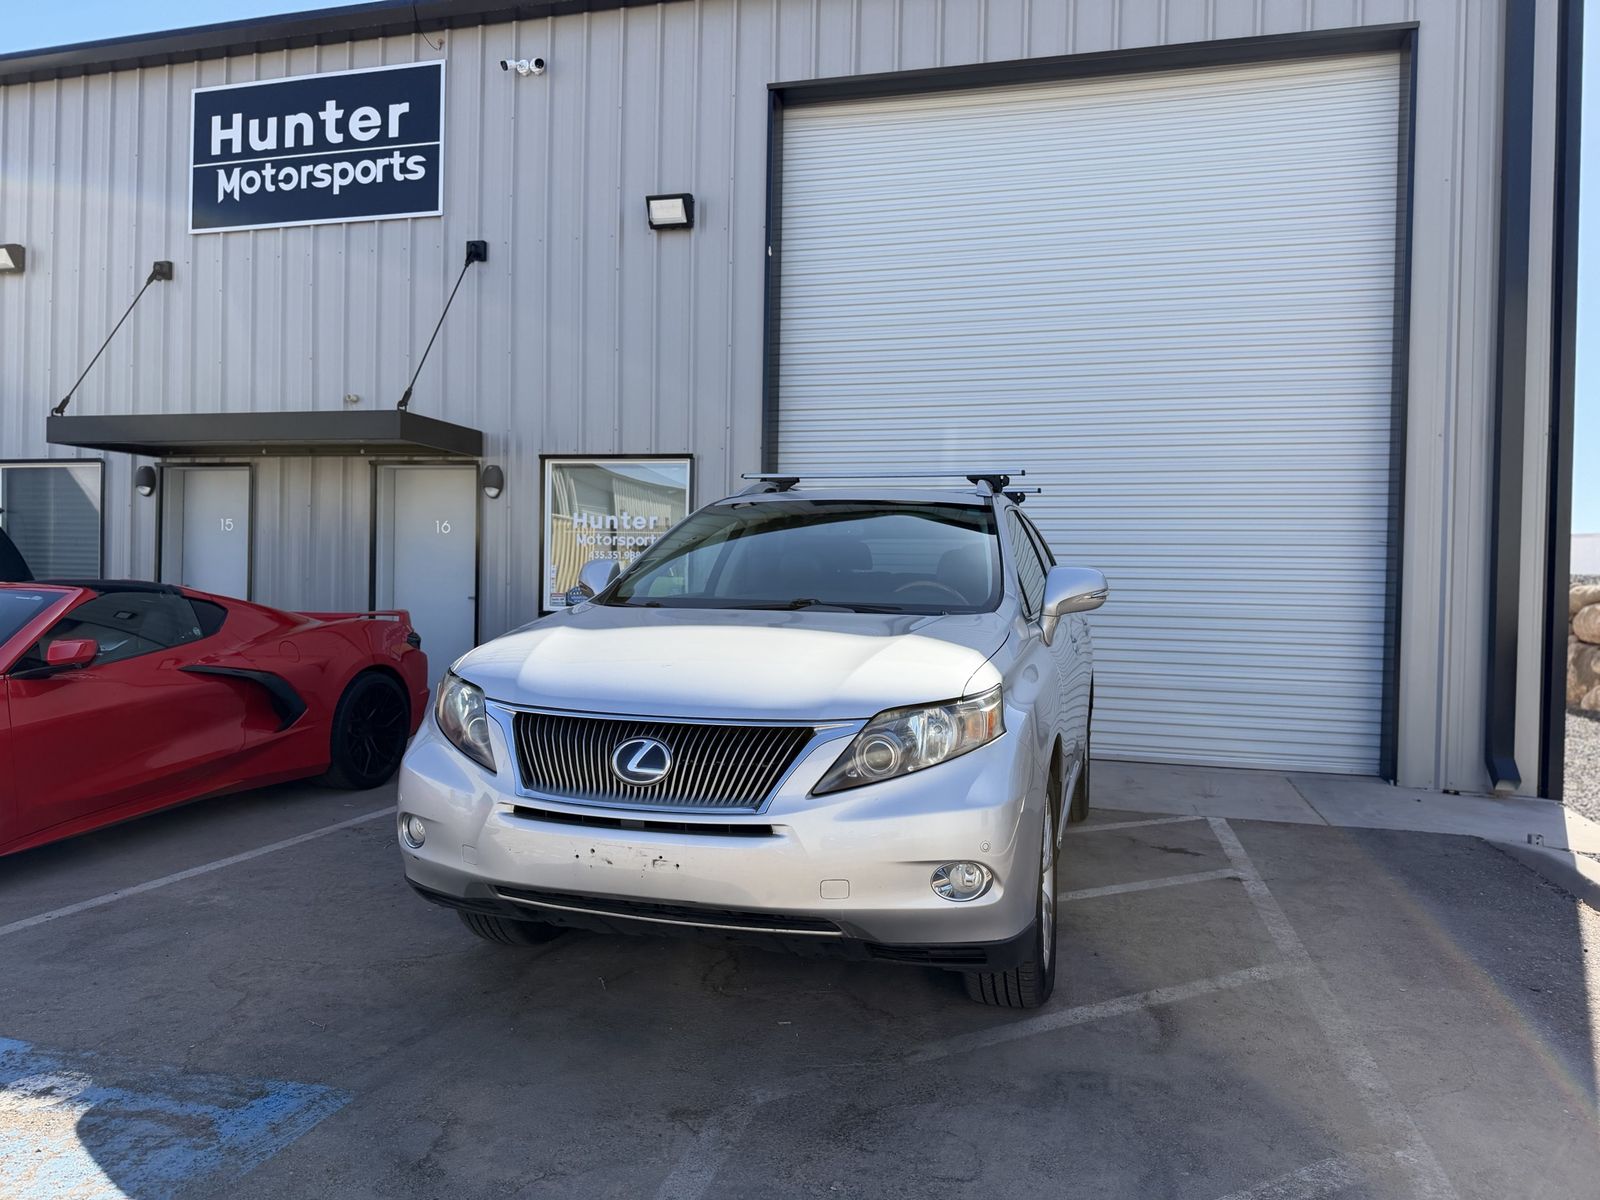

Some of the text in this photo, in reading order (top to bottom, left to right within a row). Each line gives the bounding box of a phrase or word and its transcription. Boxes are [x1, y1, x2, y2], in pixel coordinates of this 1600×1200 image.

[211, 100, 410, 156] Hunter
[216, 151, 427, 204] Motorsports
[220, 518, 234, 531] 15
[436, 520, 451, 534] 16
[573, 511, 658, 529] Hunter
